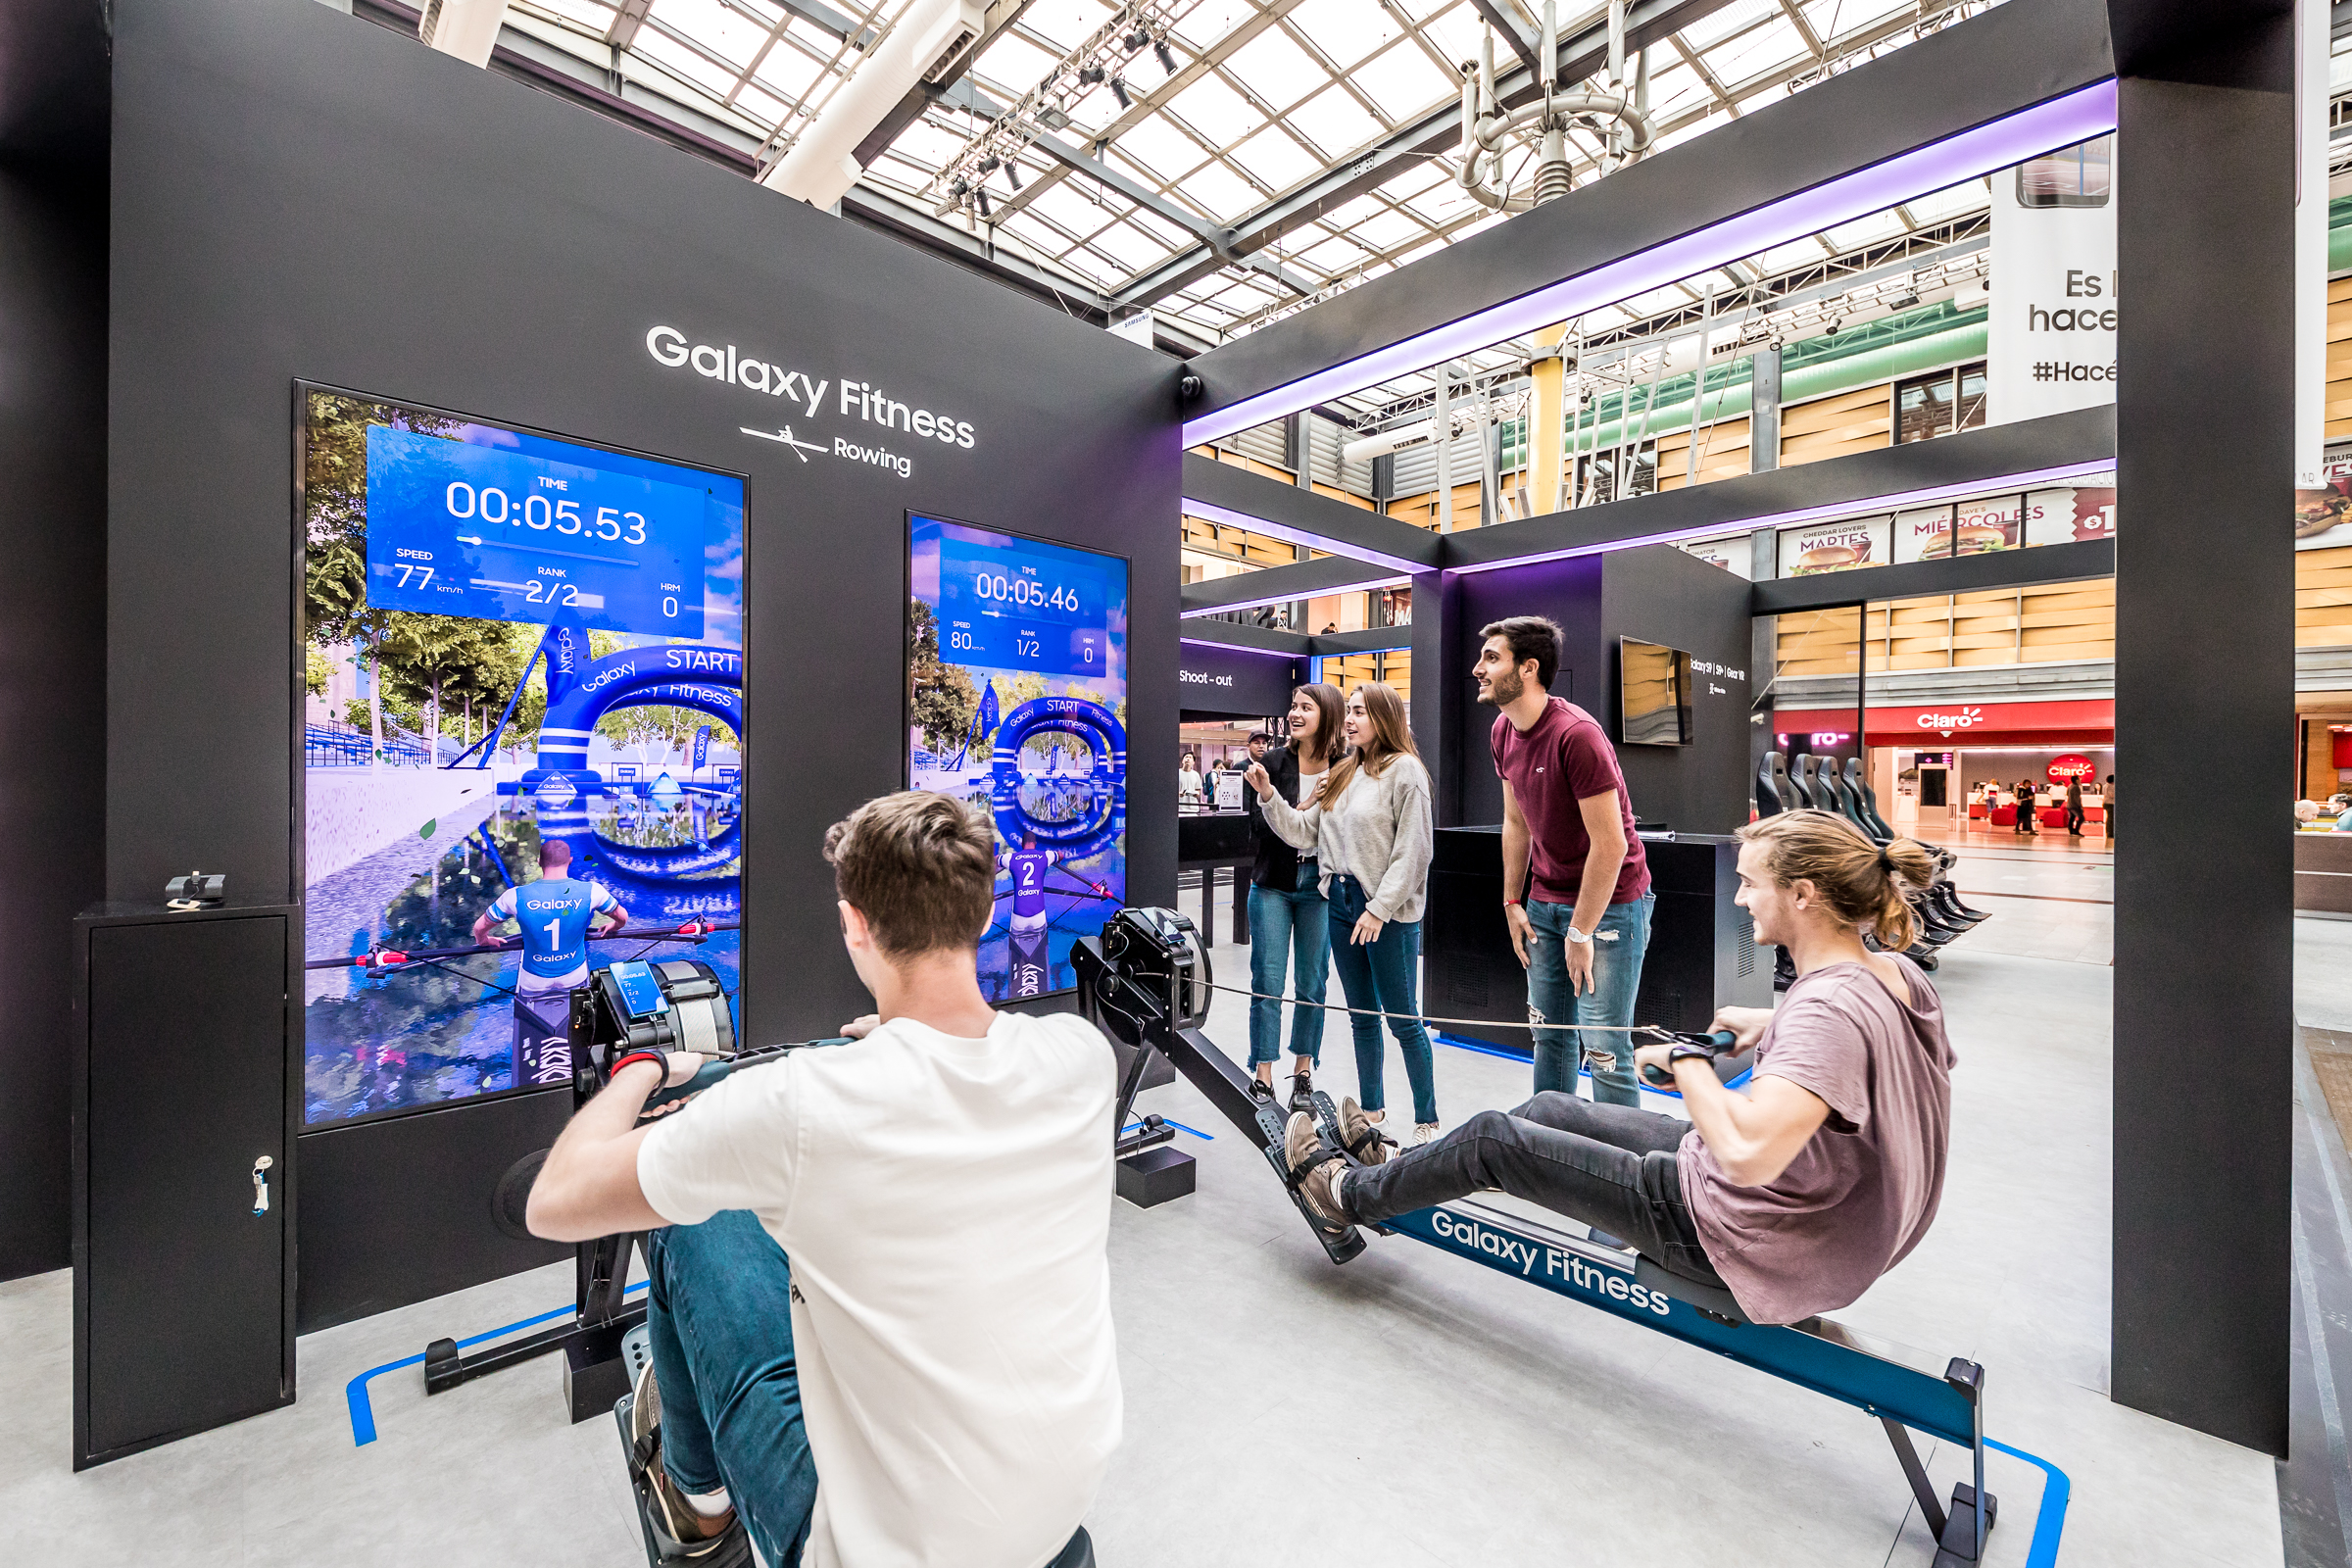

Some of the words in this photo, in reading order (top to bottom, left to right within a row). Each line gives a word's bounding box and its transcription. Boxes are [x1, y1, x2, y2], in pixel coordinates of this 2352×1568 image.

[2066, 270, 2102, 298] Es
[645, 325, 829, 418] Galaxy
[840, 378, 976, 450] Fitness
[834, 436, 911, 479] Rowing
[537, 475, 568, 492] TIME
[446, 481, 647, 546] 00:05.53
[1958, 507, 1986, 516] DAVE'S
[1802, 528, 1838, 539] CHEDDAR
[1838, 524, 1867, 534] LOVERS
[1800, 531, 1869, 553] MARTES
[396, 548, 433, 562] SPEED
[394, 563, 435, 591] 77
[436, 583, 464, 596] km/h
[537, 565, 567, 578] RANK
[1021, 565, 1037, 576] TIME
[525, 579, 579, 608] 2/2
[660, 582, 681, 594] HRM
[976, 572, 1079, 612] 00:05.46
[662, 596, 678, 618] 0
[953, 620, 971, 629] SPEED
[951, 631, 972, 650] 80
[1016, 639, 1040, 658] 1/2
[555, 627, 575, 675] Galaxy
[1084, 647, 1094, 663] 0
[665, 649, 738, 673] START
[1179, 669, 1208, 685] Shoot
[1215, 673, 1233, 687] out
[669, 683, 733, 708] Fitness
[1047, 700, 1080, 713] START
[1010, 708, 1035, 727] Galaxy
[1091, 709, 1113, 727] Fitness
[1917, 709, 1980, 728] Claro
[695, 732, 709, 760] Galaxy
[1778, 732, 1839, 747] Cro
[2048, 763, 2092, 778] Claro
[1022, 861, 1035, 887] 2
[1017, 888, 1041, 897] Galaxy
[526, 898, 583, 912] Galaxy
[543, 918, 561, 952] 1
[532, 950, 576, 963] Galaxy
[1431, 1211, 1539, 1276] Galaxy
[1546, 1248, 1671, 1316] Fitness
